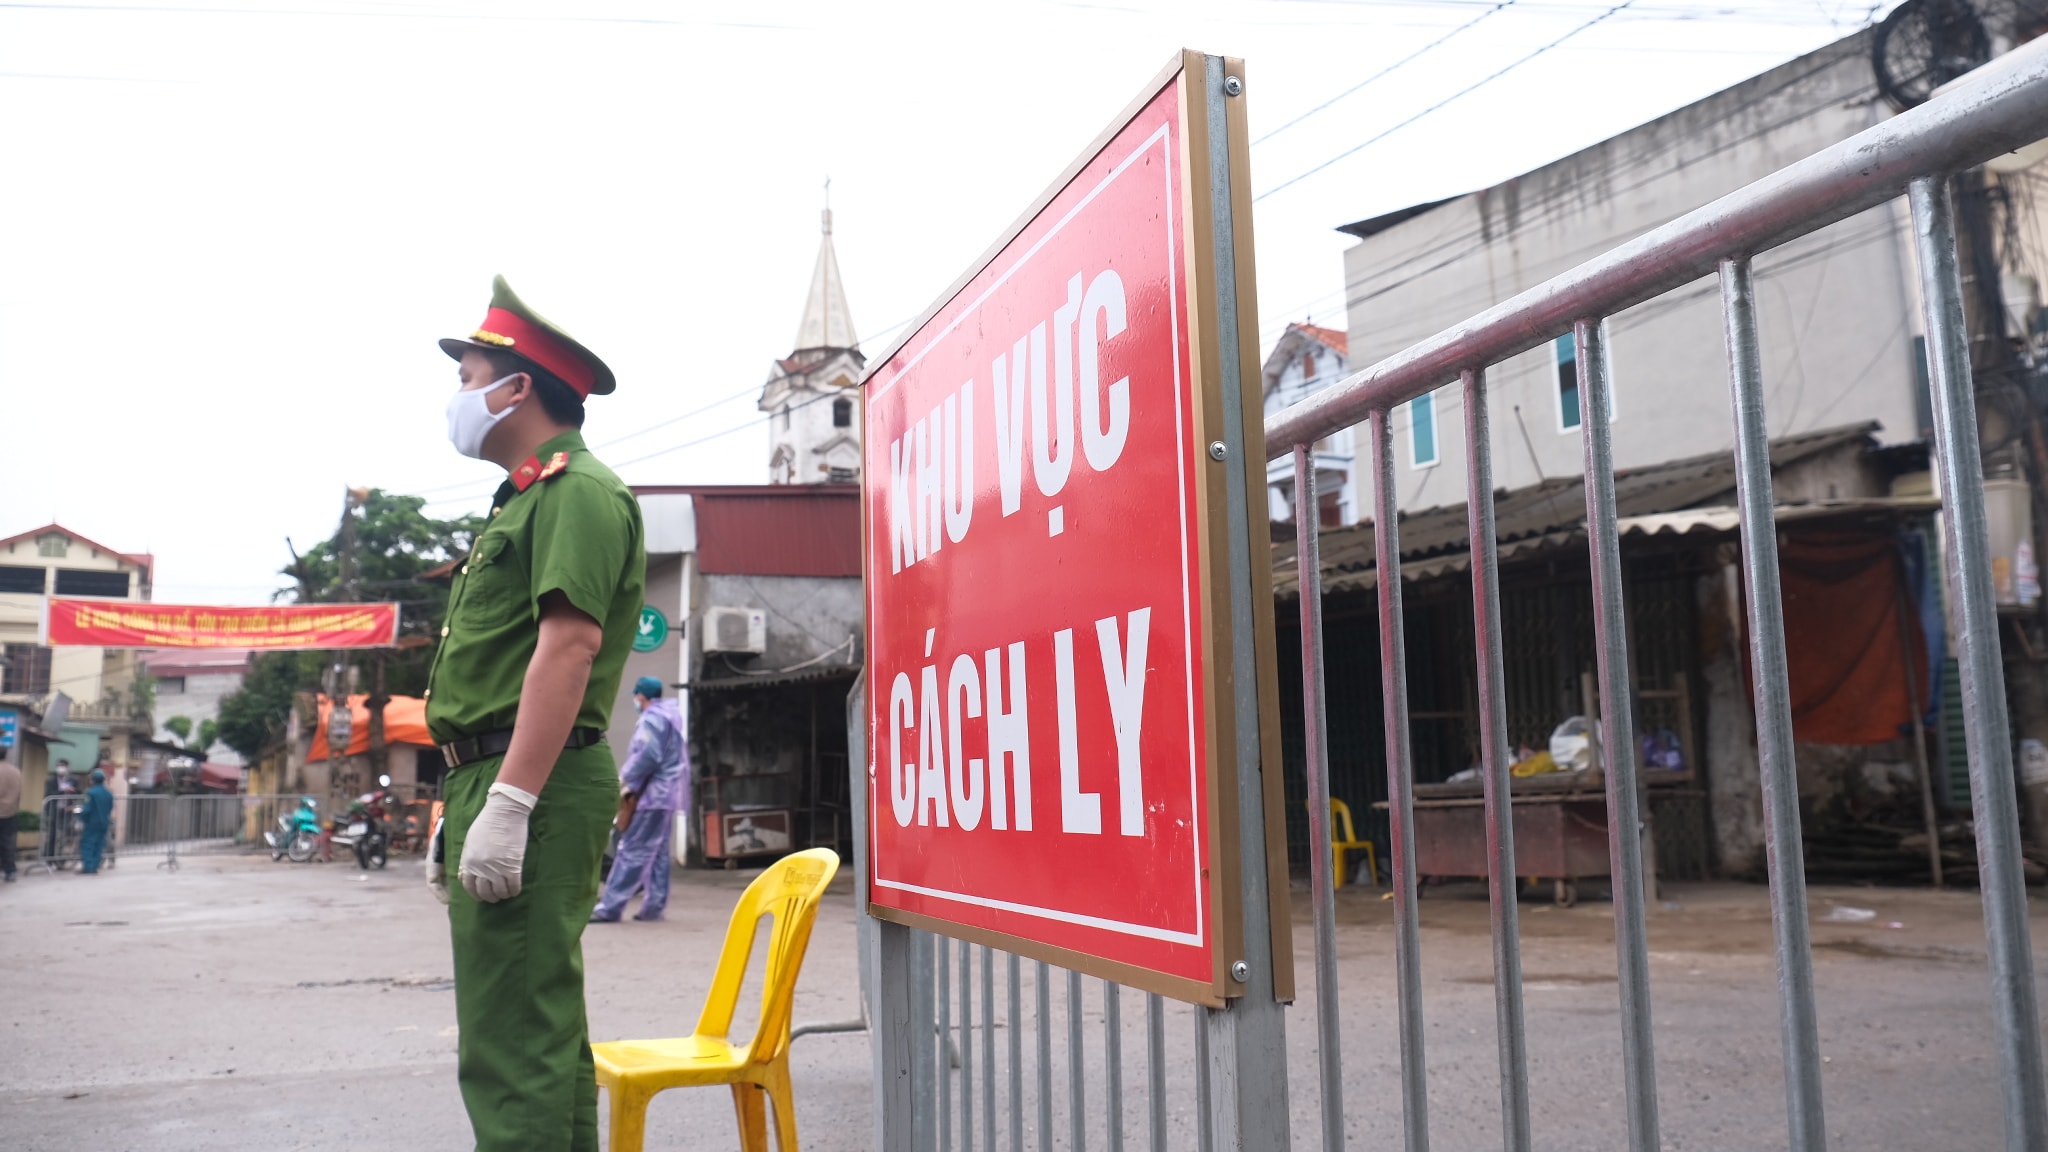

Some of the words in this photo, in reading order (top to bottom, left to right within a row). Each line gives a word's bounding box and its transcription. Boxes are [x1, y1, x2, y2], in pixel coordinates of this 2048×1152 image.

[891, 378, 973, 575] KHU
[992, 269, 1130, 538] VỰC
[890, 627, 1033, 831] CÁCH
[1054, 606, 1151, 836] LY
